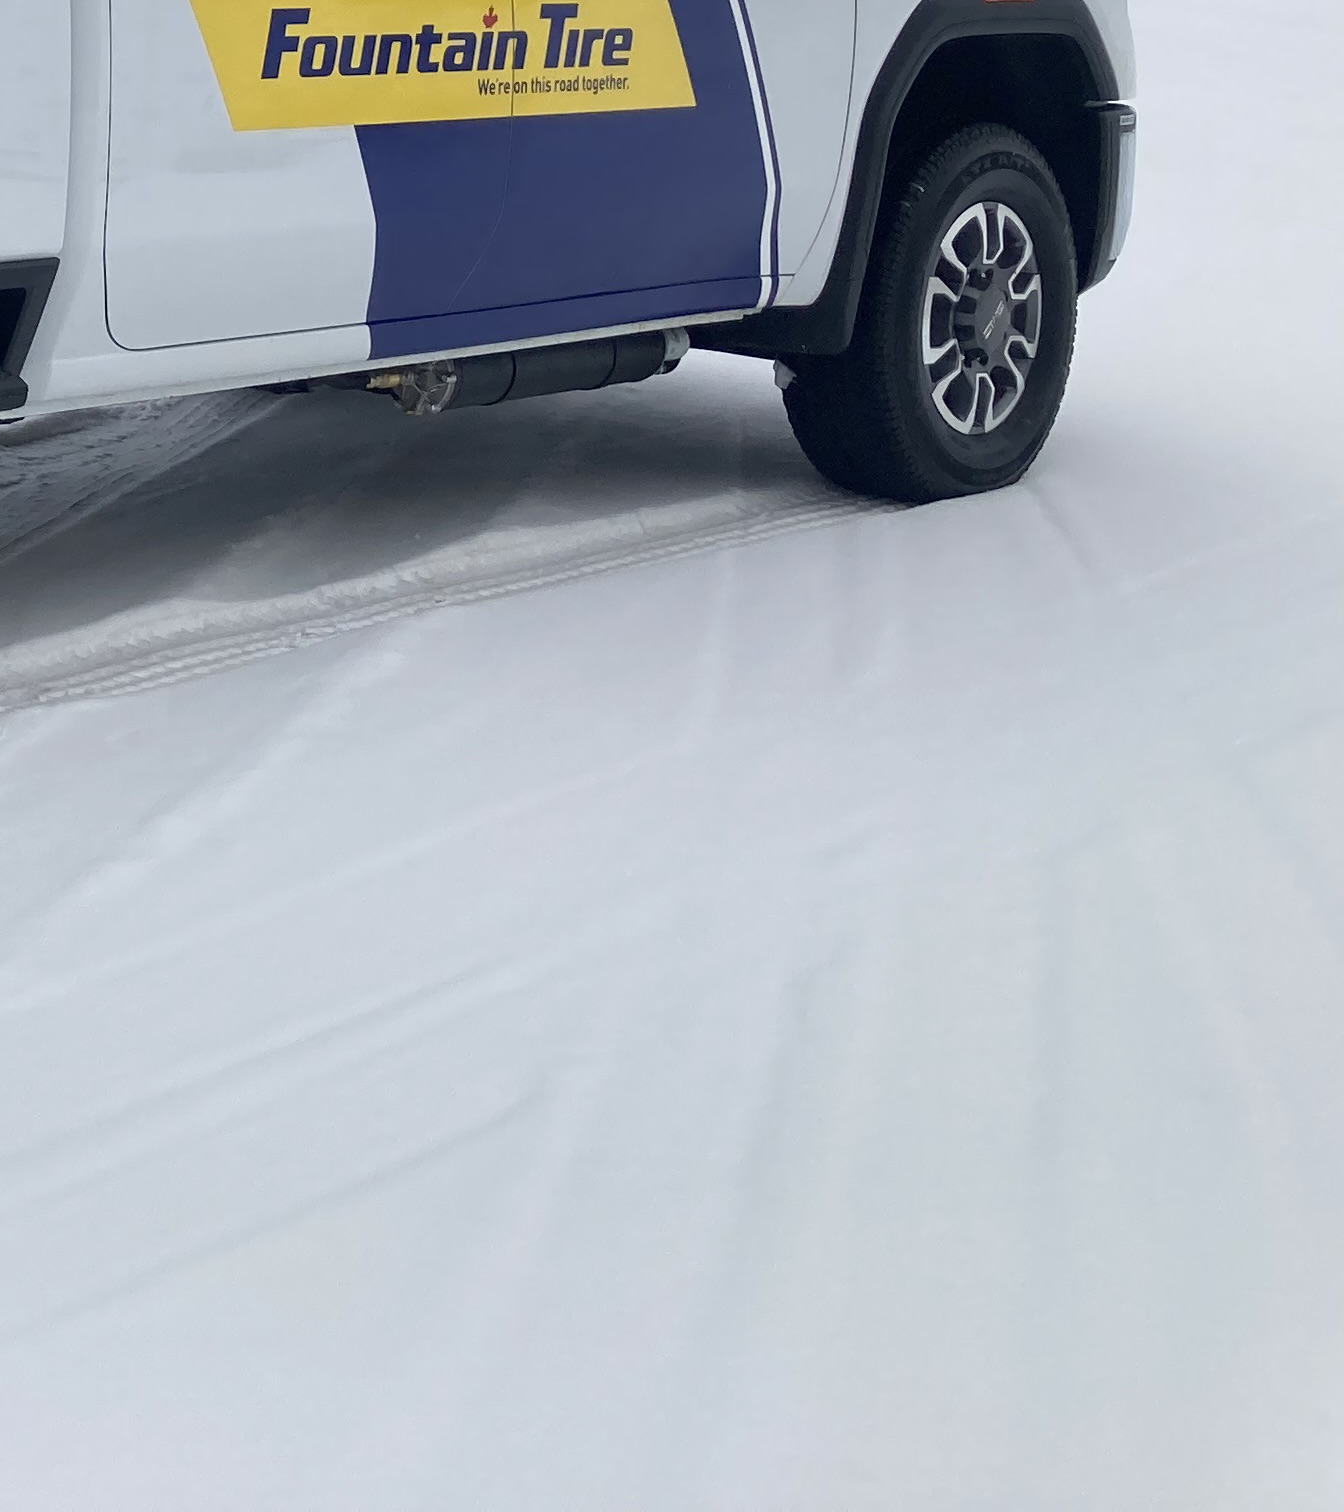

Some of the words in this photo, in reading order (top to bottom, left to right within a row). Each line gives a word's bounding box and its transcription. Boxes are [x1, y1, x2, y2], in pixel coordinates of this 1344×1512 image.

[260, 6, 528, 80] Fountain
[539, 2, 633, 70] Tire
[477, 78, 511, 96] We're
[513, 80, 528, 94] on
[530, 75, 552, 94] this
[554, 75, 580, 93] road
[582, 74, 630, 96] together.
